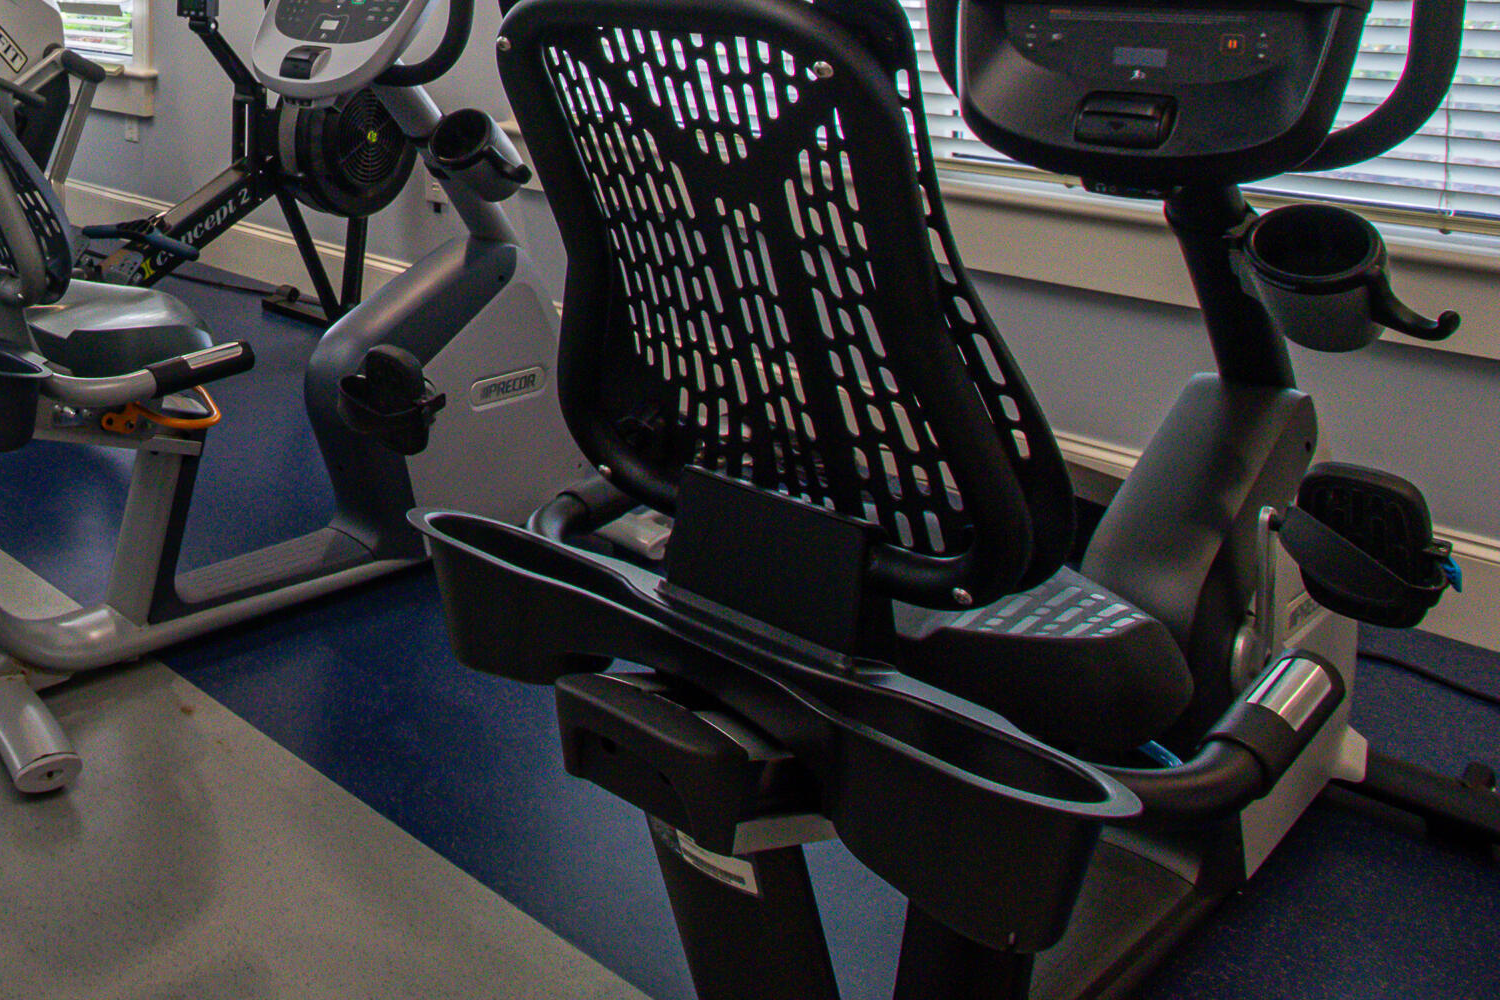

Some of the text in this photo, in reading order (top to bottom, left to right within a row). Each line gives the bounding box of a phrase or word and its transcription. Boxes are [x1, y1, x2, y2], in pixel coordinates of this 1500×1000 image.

[156, 187, 250, 267] cncept 2
[484, 373, 537, 398] PRECOR
